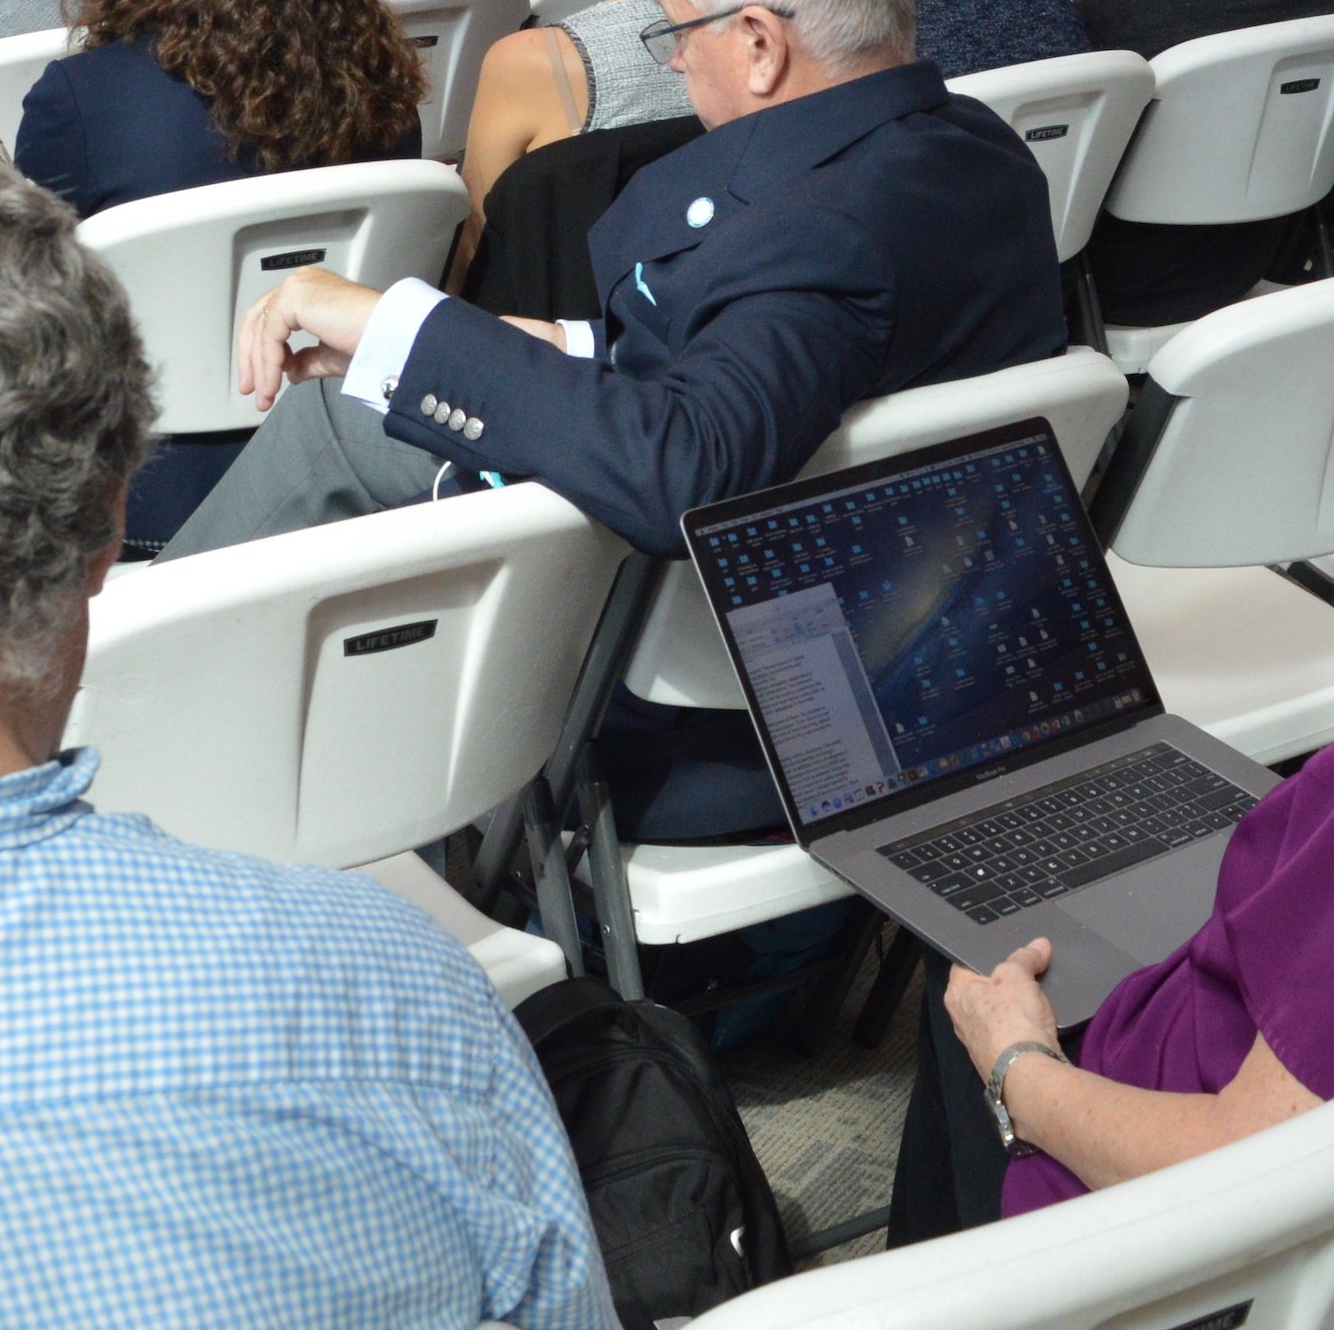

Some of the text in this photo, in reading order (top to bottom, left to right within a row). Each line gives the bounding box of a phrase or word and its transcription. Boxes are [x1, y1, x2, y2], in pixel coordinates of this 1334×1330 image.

[1029, 127, 1065, 140] LIFETIME
[268, 252, 319, 268] LIFETIME
[356, 626, 426, 652] LIFETIME
